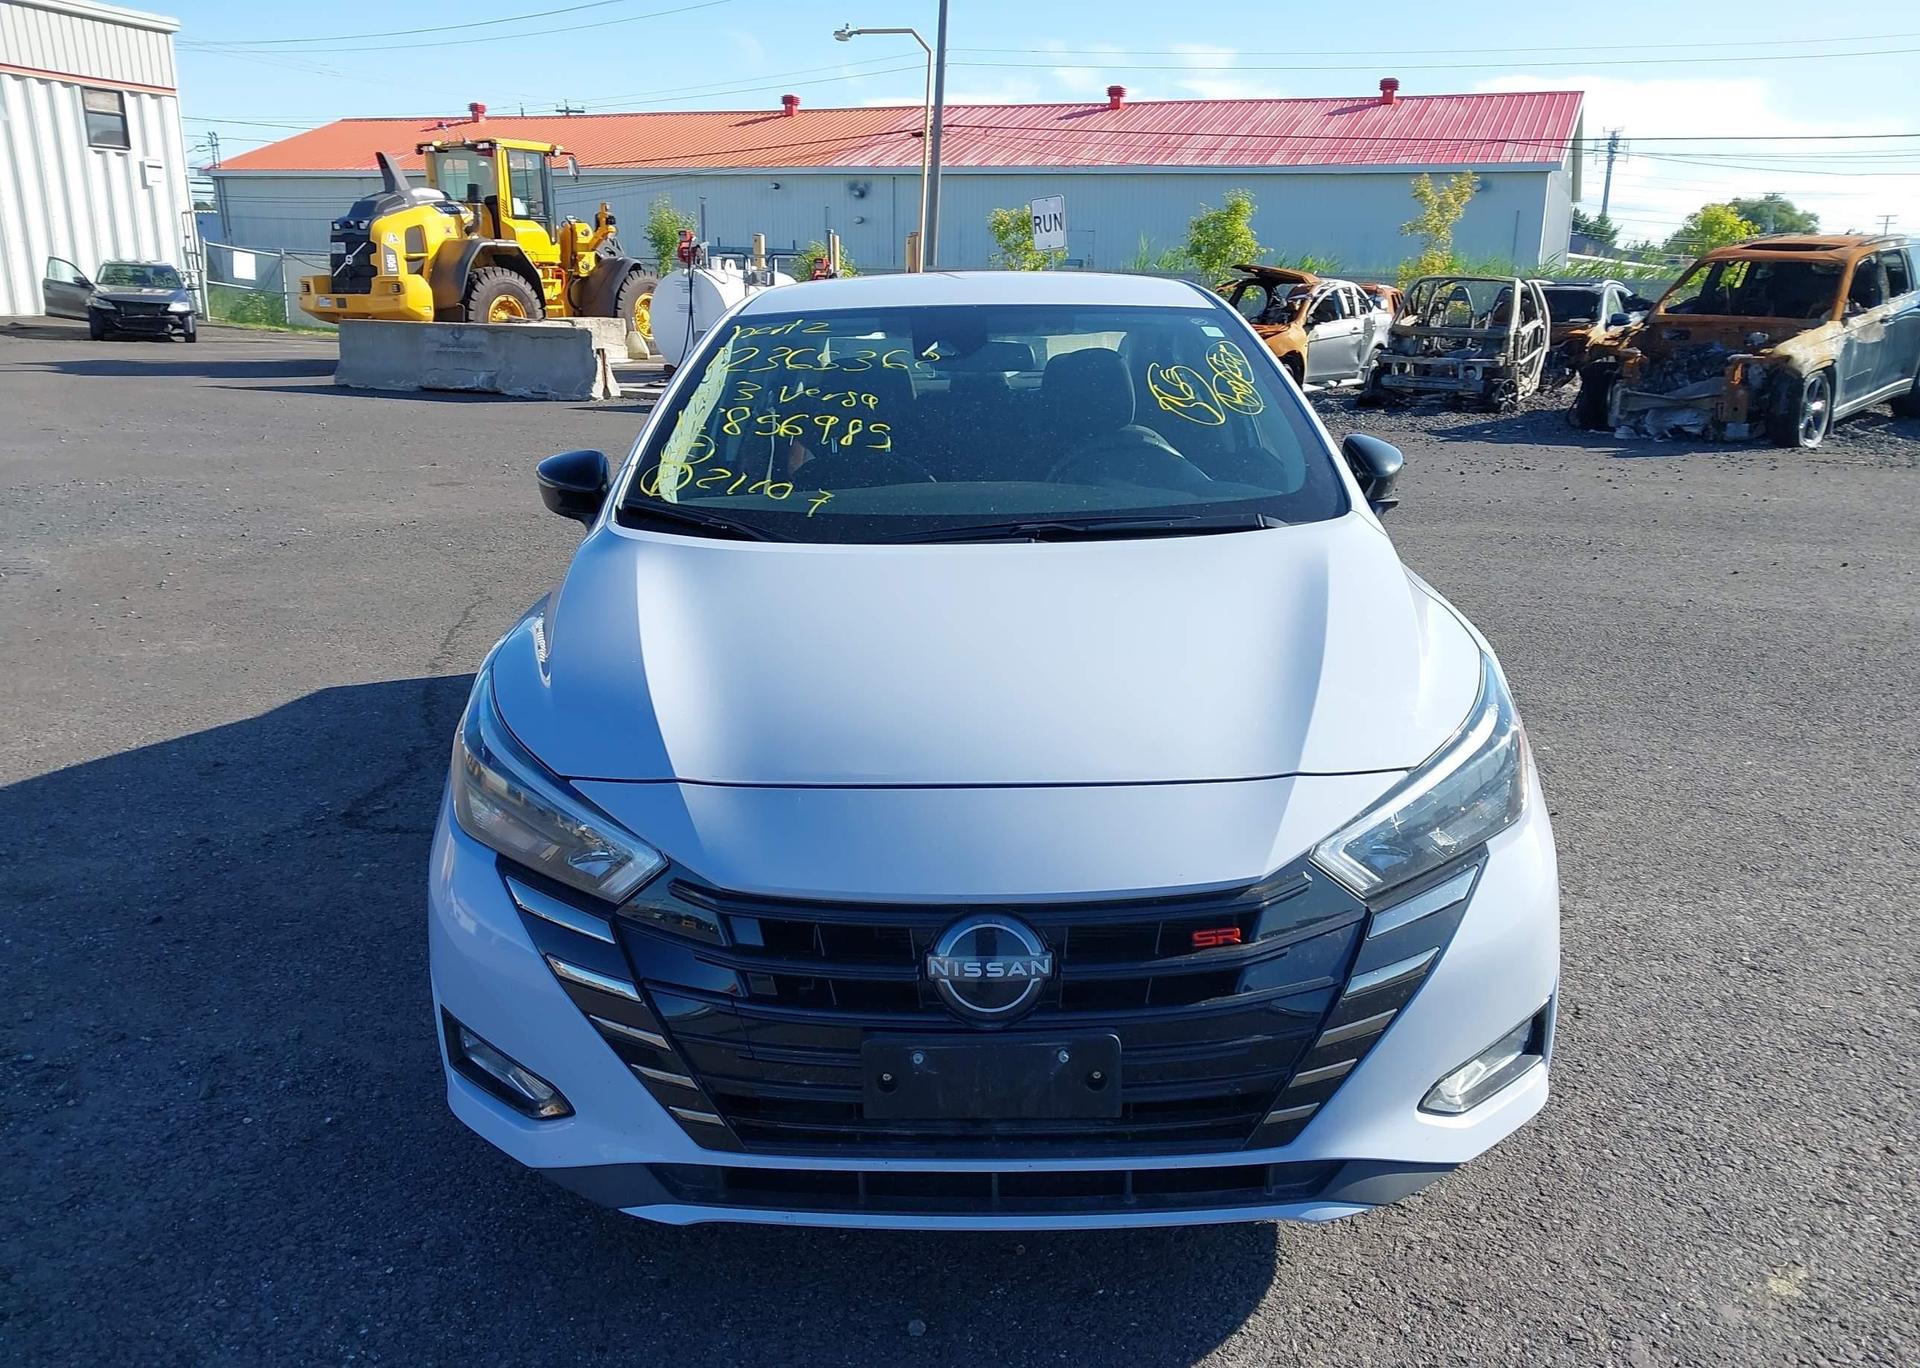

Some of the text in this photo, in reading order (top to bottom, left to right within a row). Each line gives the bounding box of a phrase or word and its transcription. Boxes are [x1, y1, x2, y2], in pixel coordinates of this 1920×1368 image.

[1033, 212, 1063, 234] RUN
[1193, 927, 1242, 948] SR
[930, 959, 1049, 978] NISSAN
